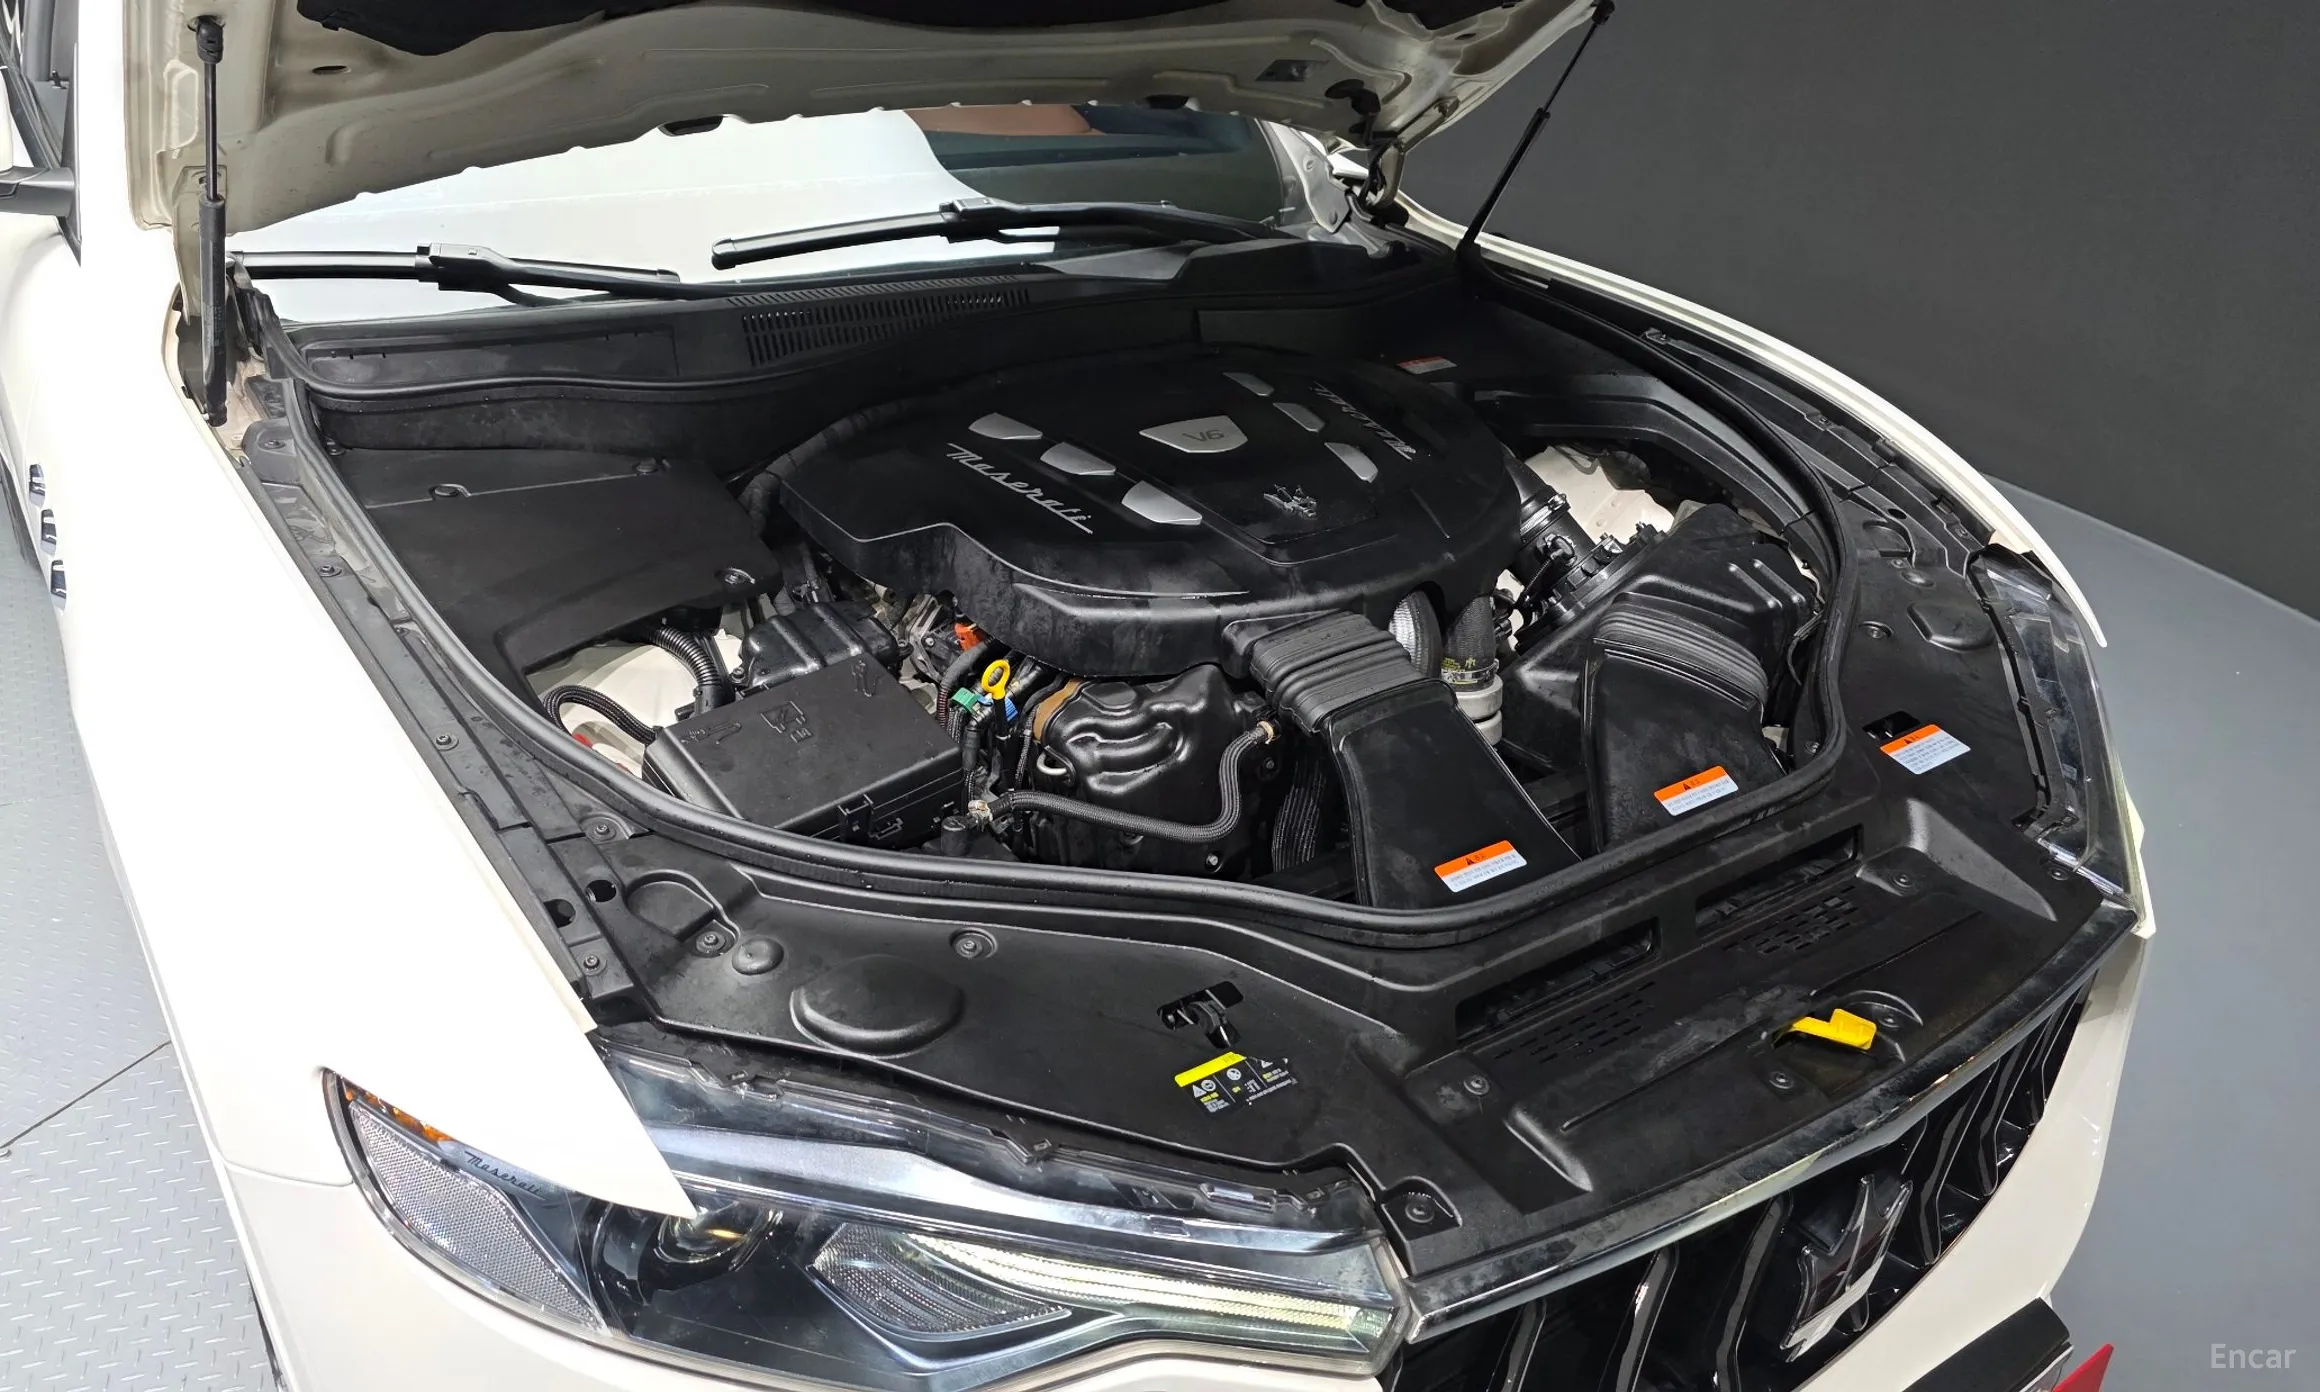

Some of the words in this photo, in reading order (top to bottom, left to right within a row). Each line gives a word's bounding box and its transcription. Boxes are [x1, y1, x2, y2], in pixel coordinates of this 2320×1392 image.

[1182, 429, 1225, 442] V6
[946, 442, 1094, 535] Maserati
[464, 1150, 547, 1201] Maserati
